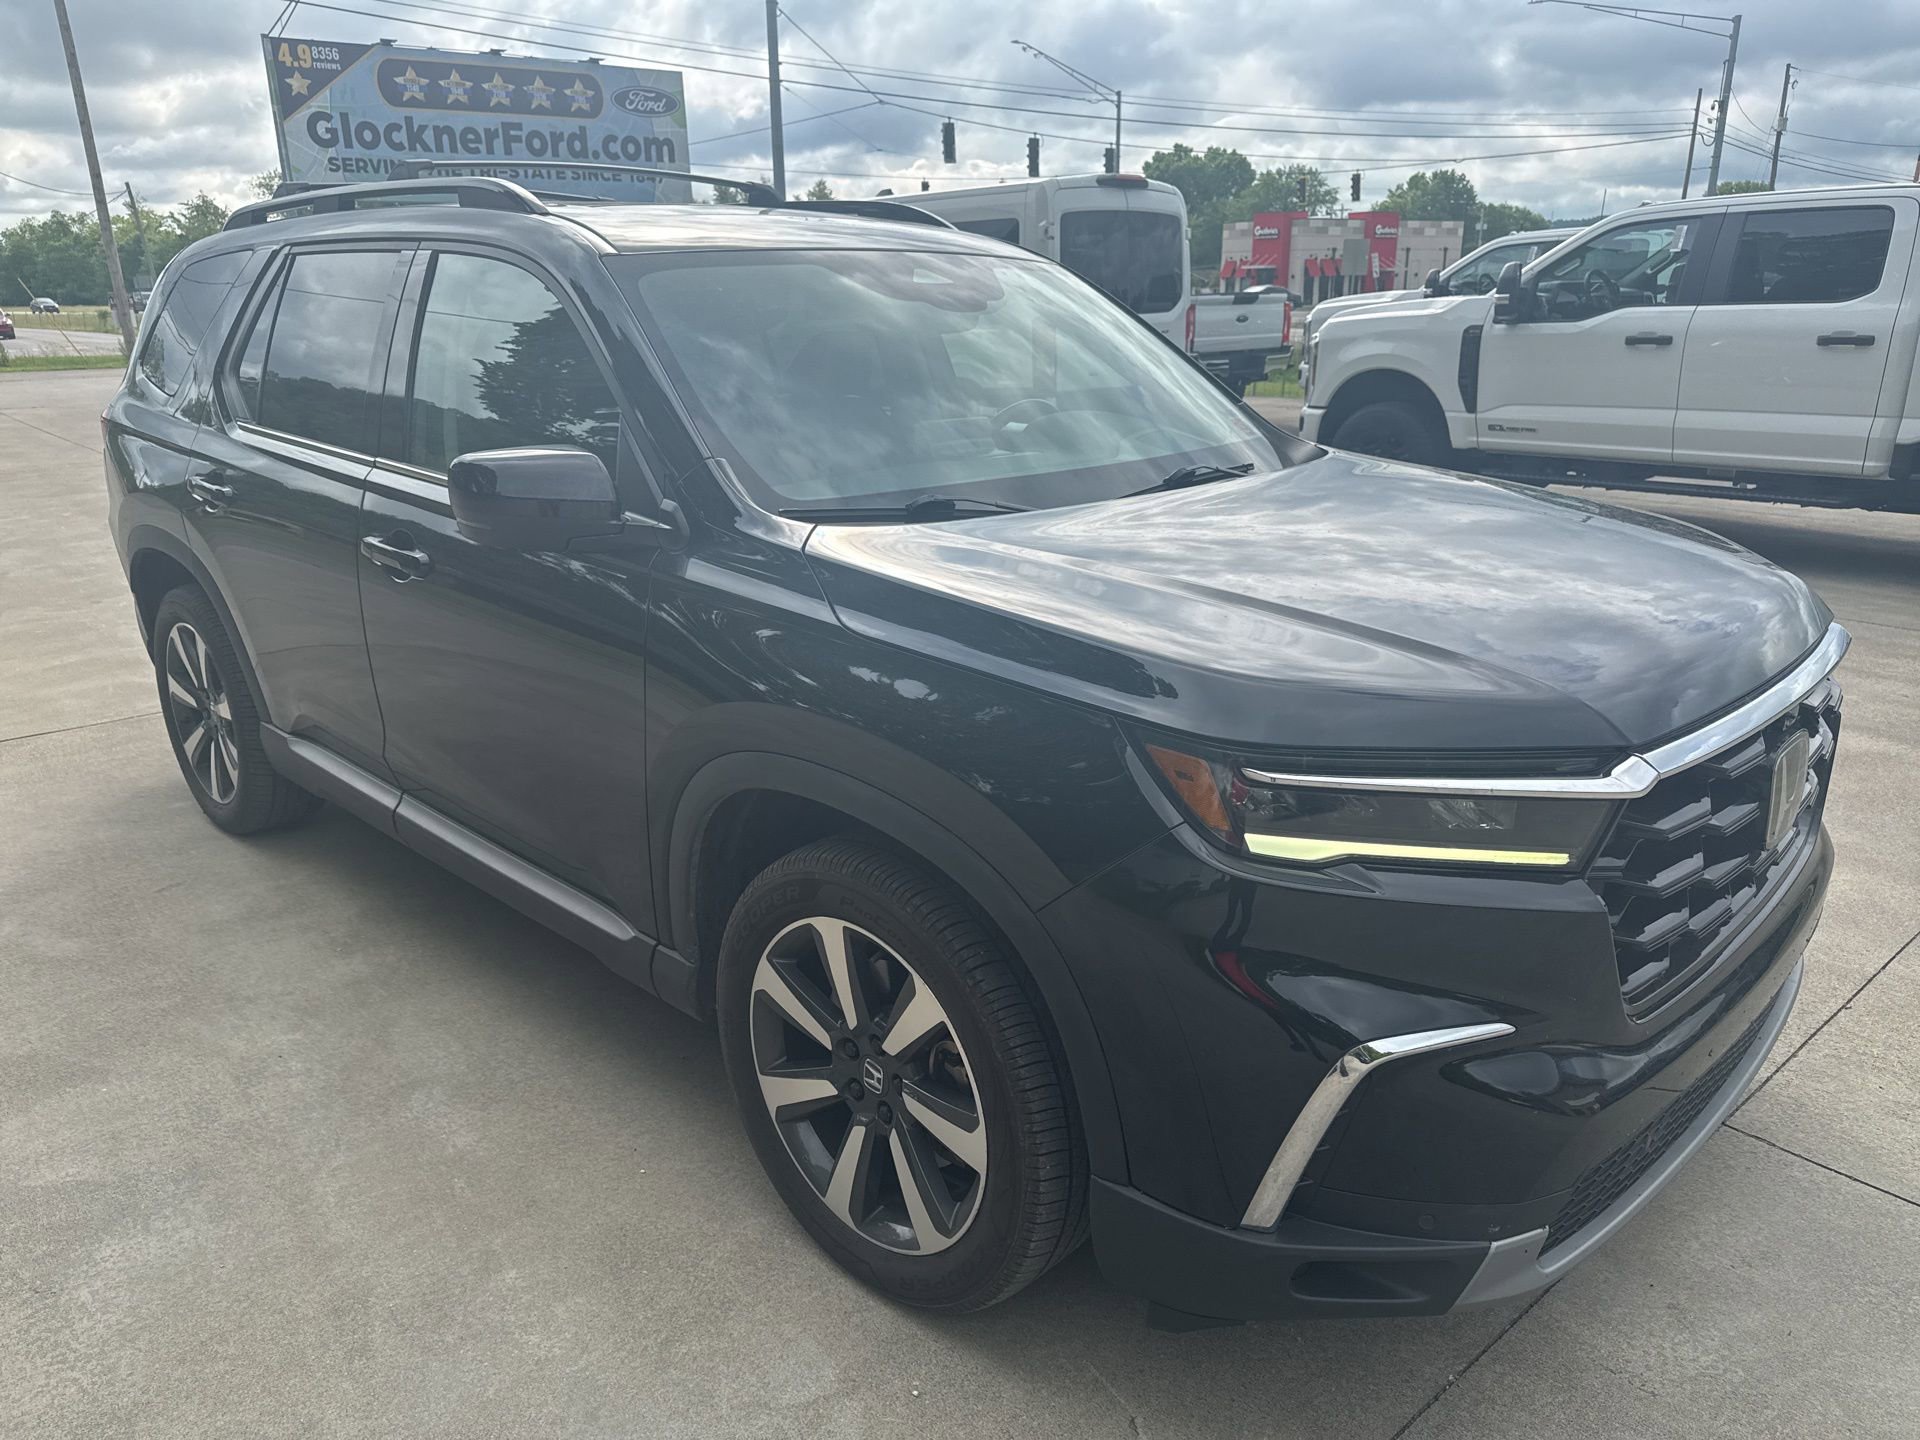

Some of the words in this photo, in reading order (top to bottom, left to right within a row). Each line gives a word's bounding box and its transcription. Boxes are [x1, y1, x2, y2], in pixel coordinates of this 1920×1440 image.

[278, 42, 312, 69] 4.9
[311, 46, 340, 61] 8356
[312, 61, 341, 71] reviews
[625, 90, 667, 113] Ford
[306, 110, 676, 164] GlocknerFord.com
